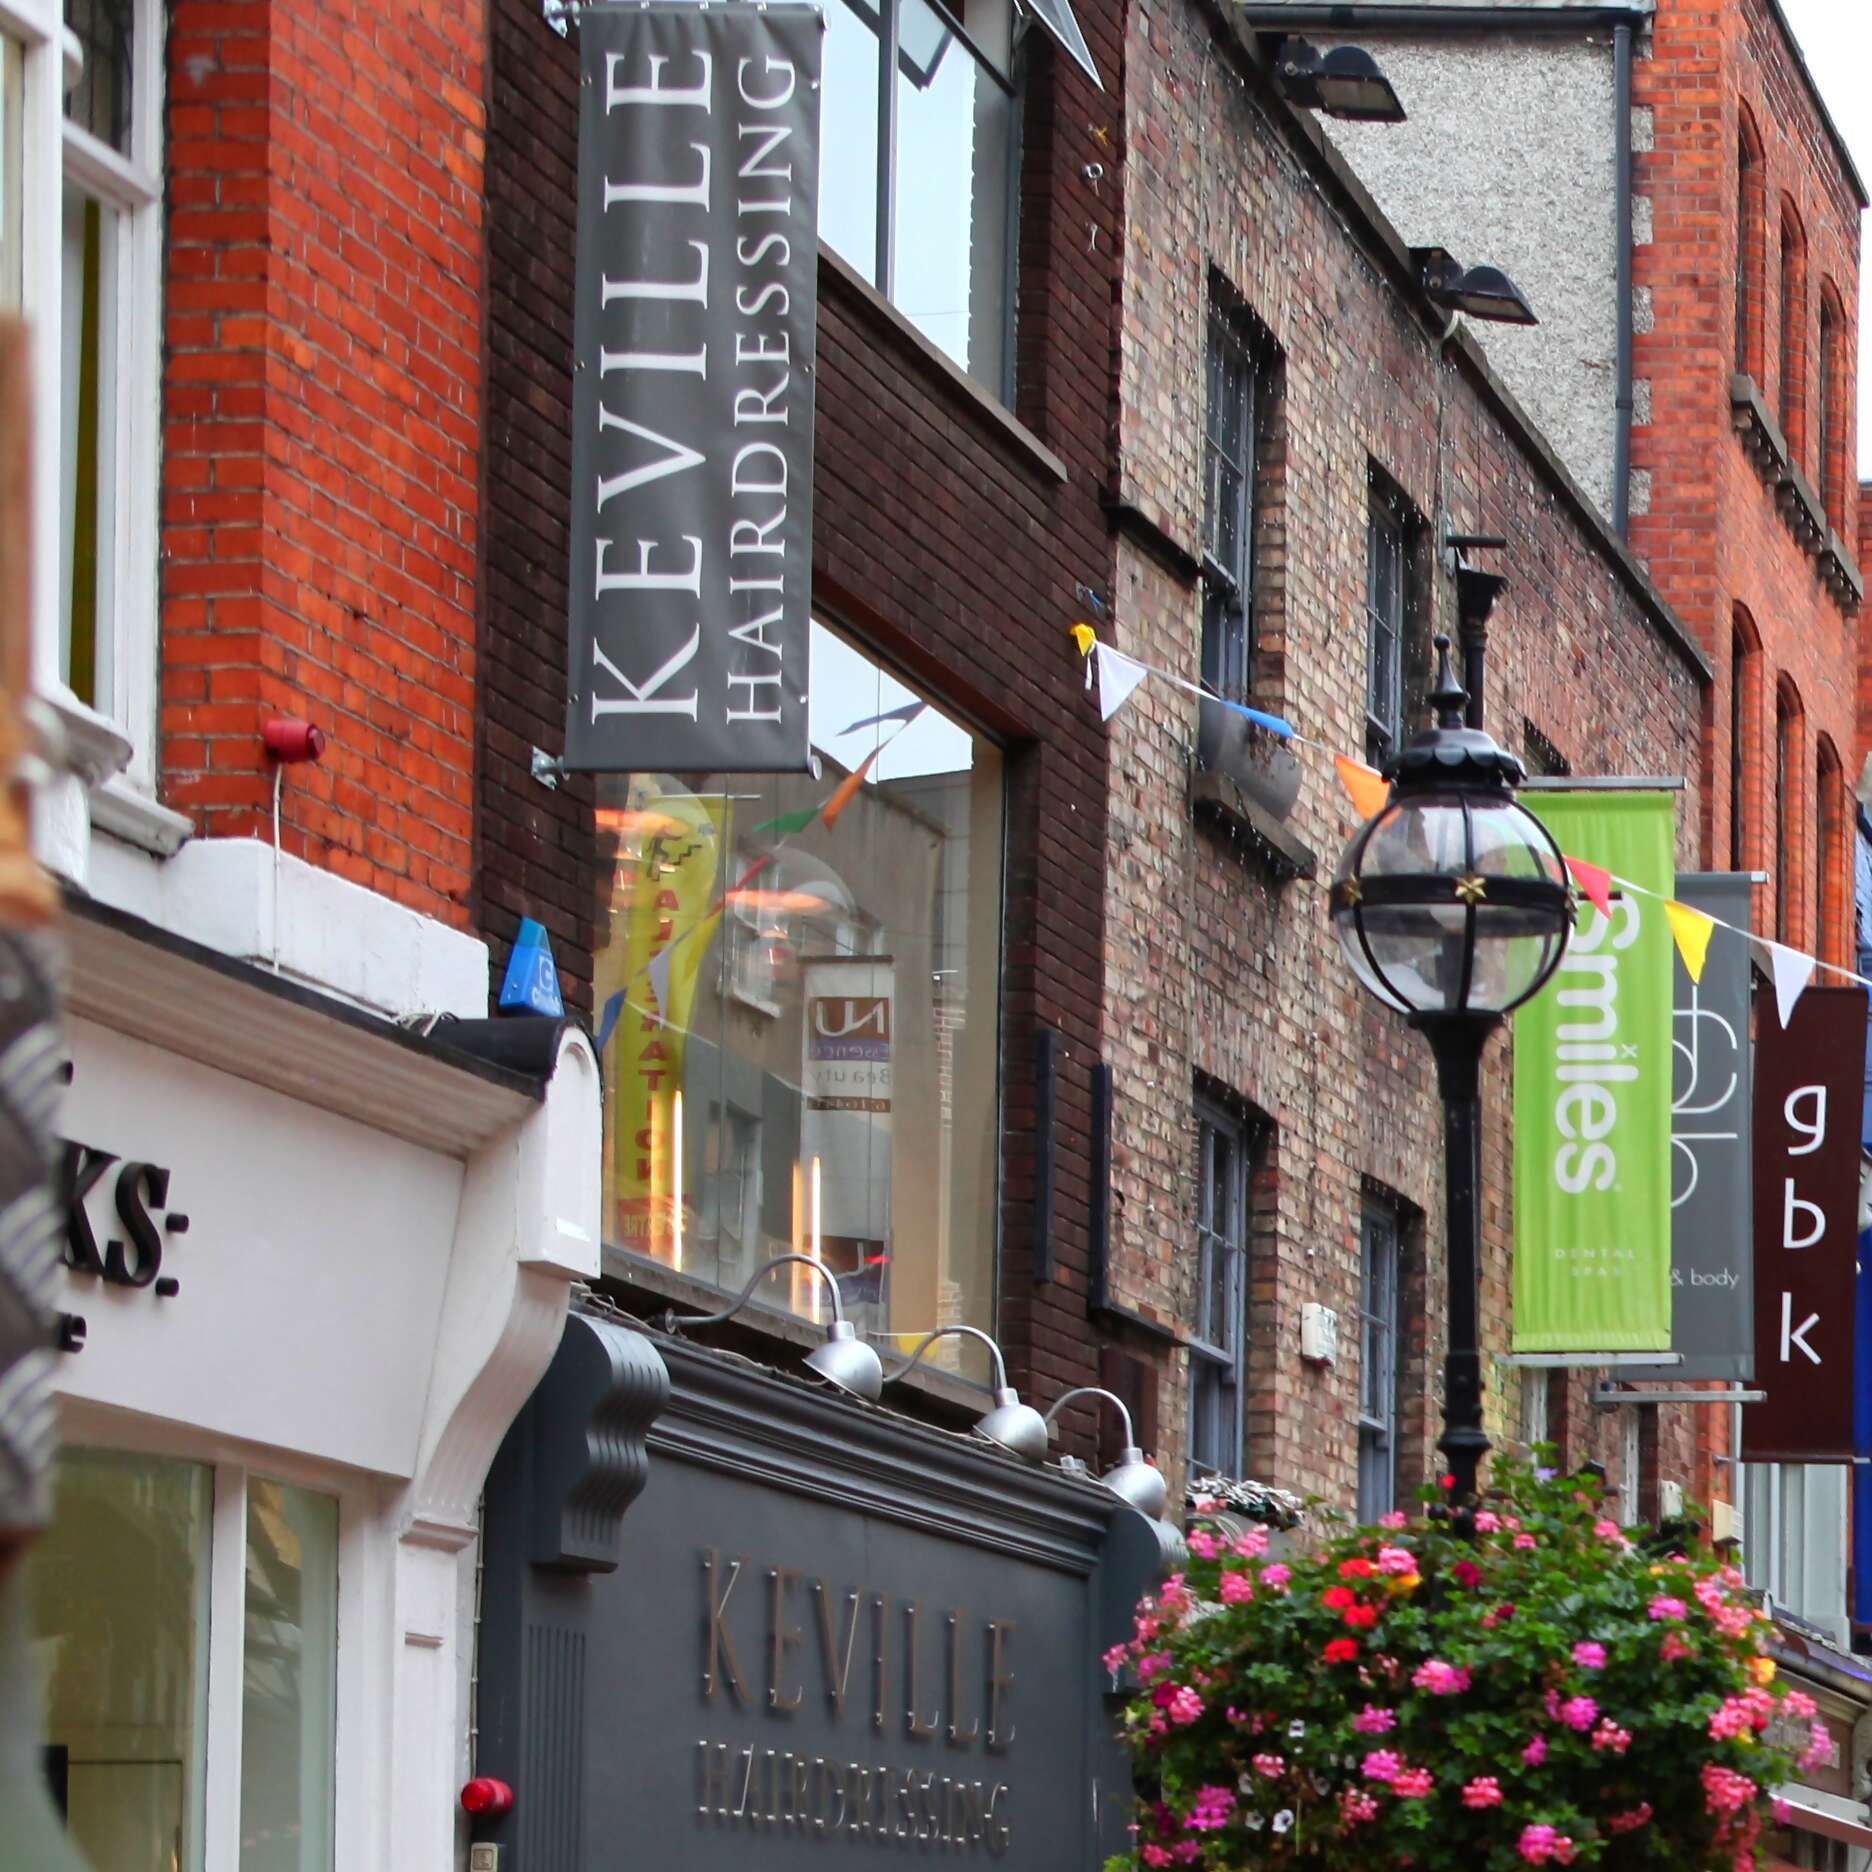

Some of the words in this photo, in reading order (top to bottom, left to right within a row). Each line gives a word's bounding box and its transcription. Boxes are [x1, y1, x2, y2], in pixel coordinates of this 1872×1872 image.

[591, 49, 714, 726] KEVILLE
[726, 55, 797, 726] HAIRDRESSING
[1690, 1268, 1740, 1289] body
[704, 1548, 1018, 1750] KEVILLE
